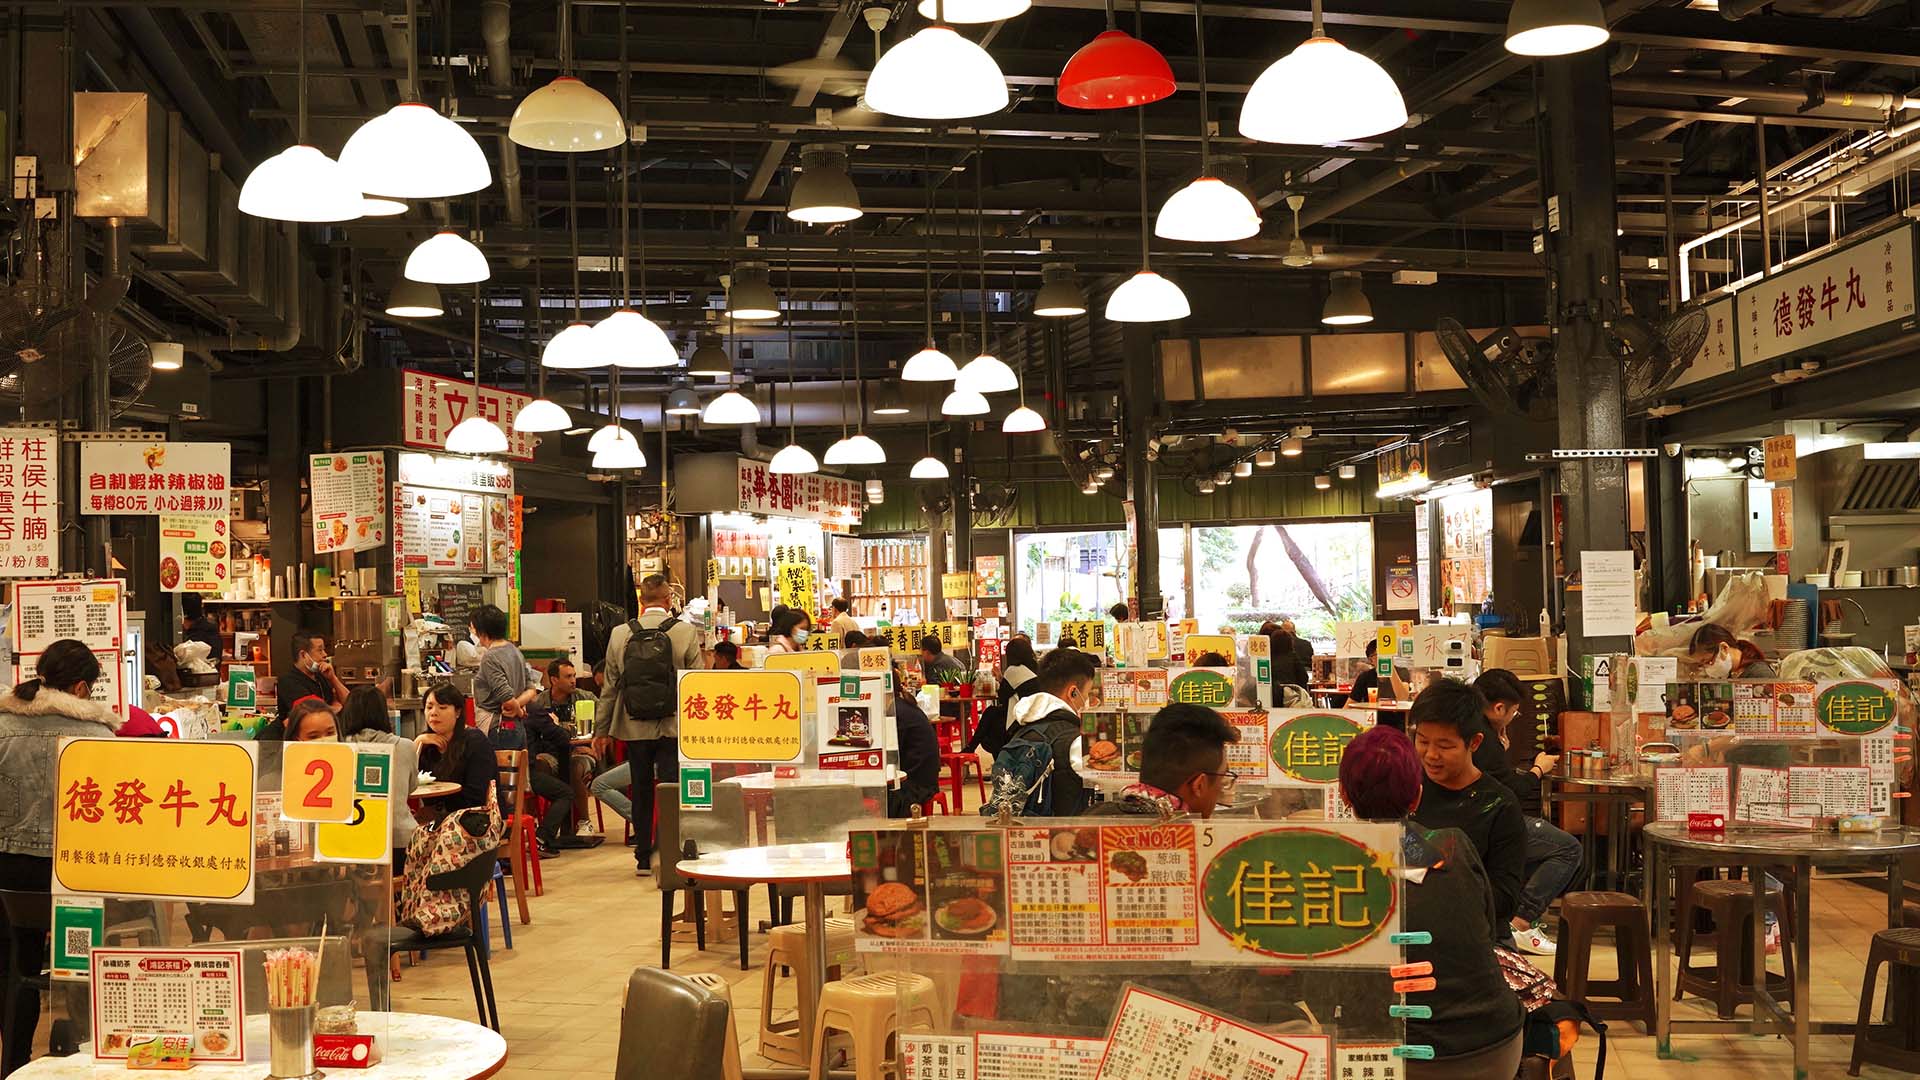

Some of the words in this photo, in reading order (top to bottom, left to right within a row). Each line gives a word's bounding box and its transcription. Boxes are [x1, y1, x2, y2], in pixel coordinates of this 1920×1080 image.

[1773, 267, 1866, 338] 德發牛丸
[415, 377, 424, 441] 海南雞飯
[21, 437, 48, 541] 柱侯牛腩
[752, 465, 794, 512] 華香園
[90, 494, 148, 511] 每樽80元
[1382, 634, 1391, 648] 9
[1401, 623, 1409, 636] 8
[862, 653, 887, 668] 德發
[1177, 680, 1227, 704] 佳記
[683, 692, 799, 722] 德發牛丸
[1366, 712, 1374, 726] 4
[1825, 695, 1887, 724] 佳記
[302, 758, 334, 809] 2
[63, 776, 248, 828] 德發牛丸
[1202, 827, 1214, 847] 5
[60, 848, 248, 871] 用餐後請自行到德發收銀處付款
[1226, 860, 1371, 929] 佳記
[163, 1035, 190, 1050] 安佳
